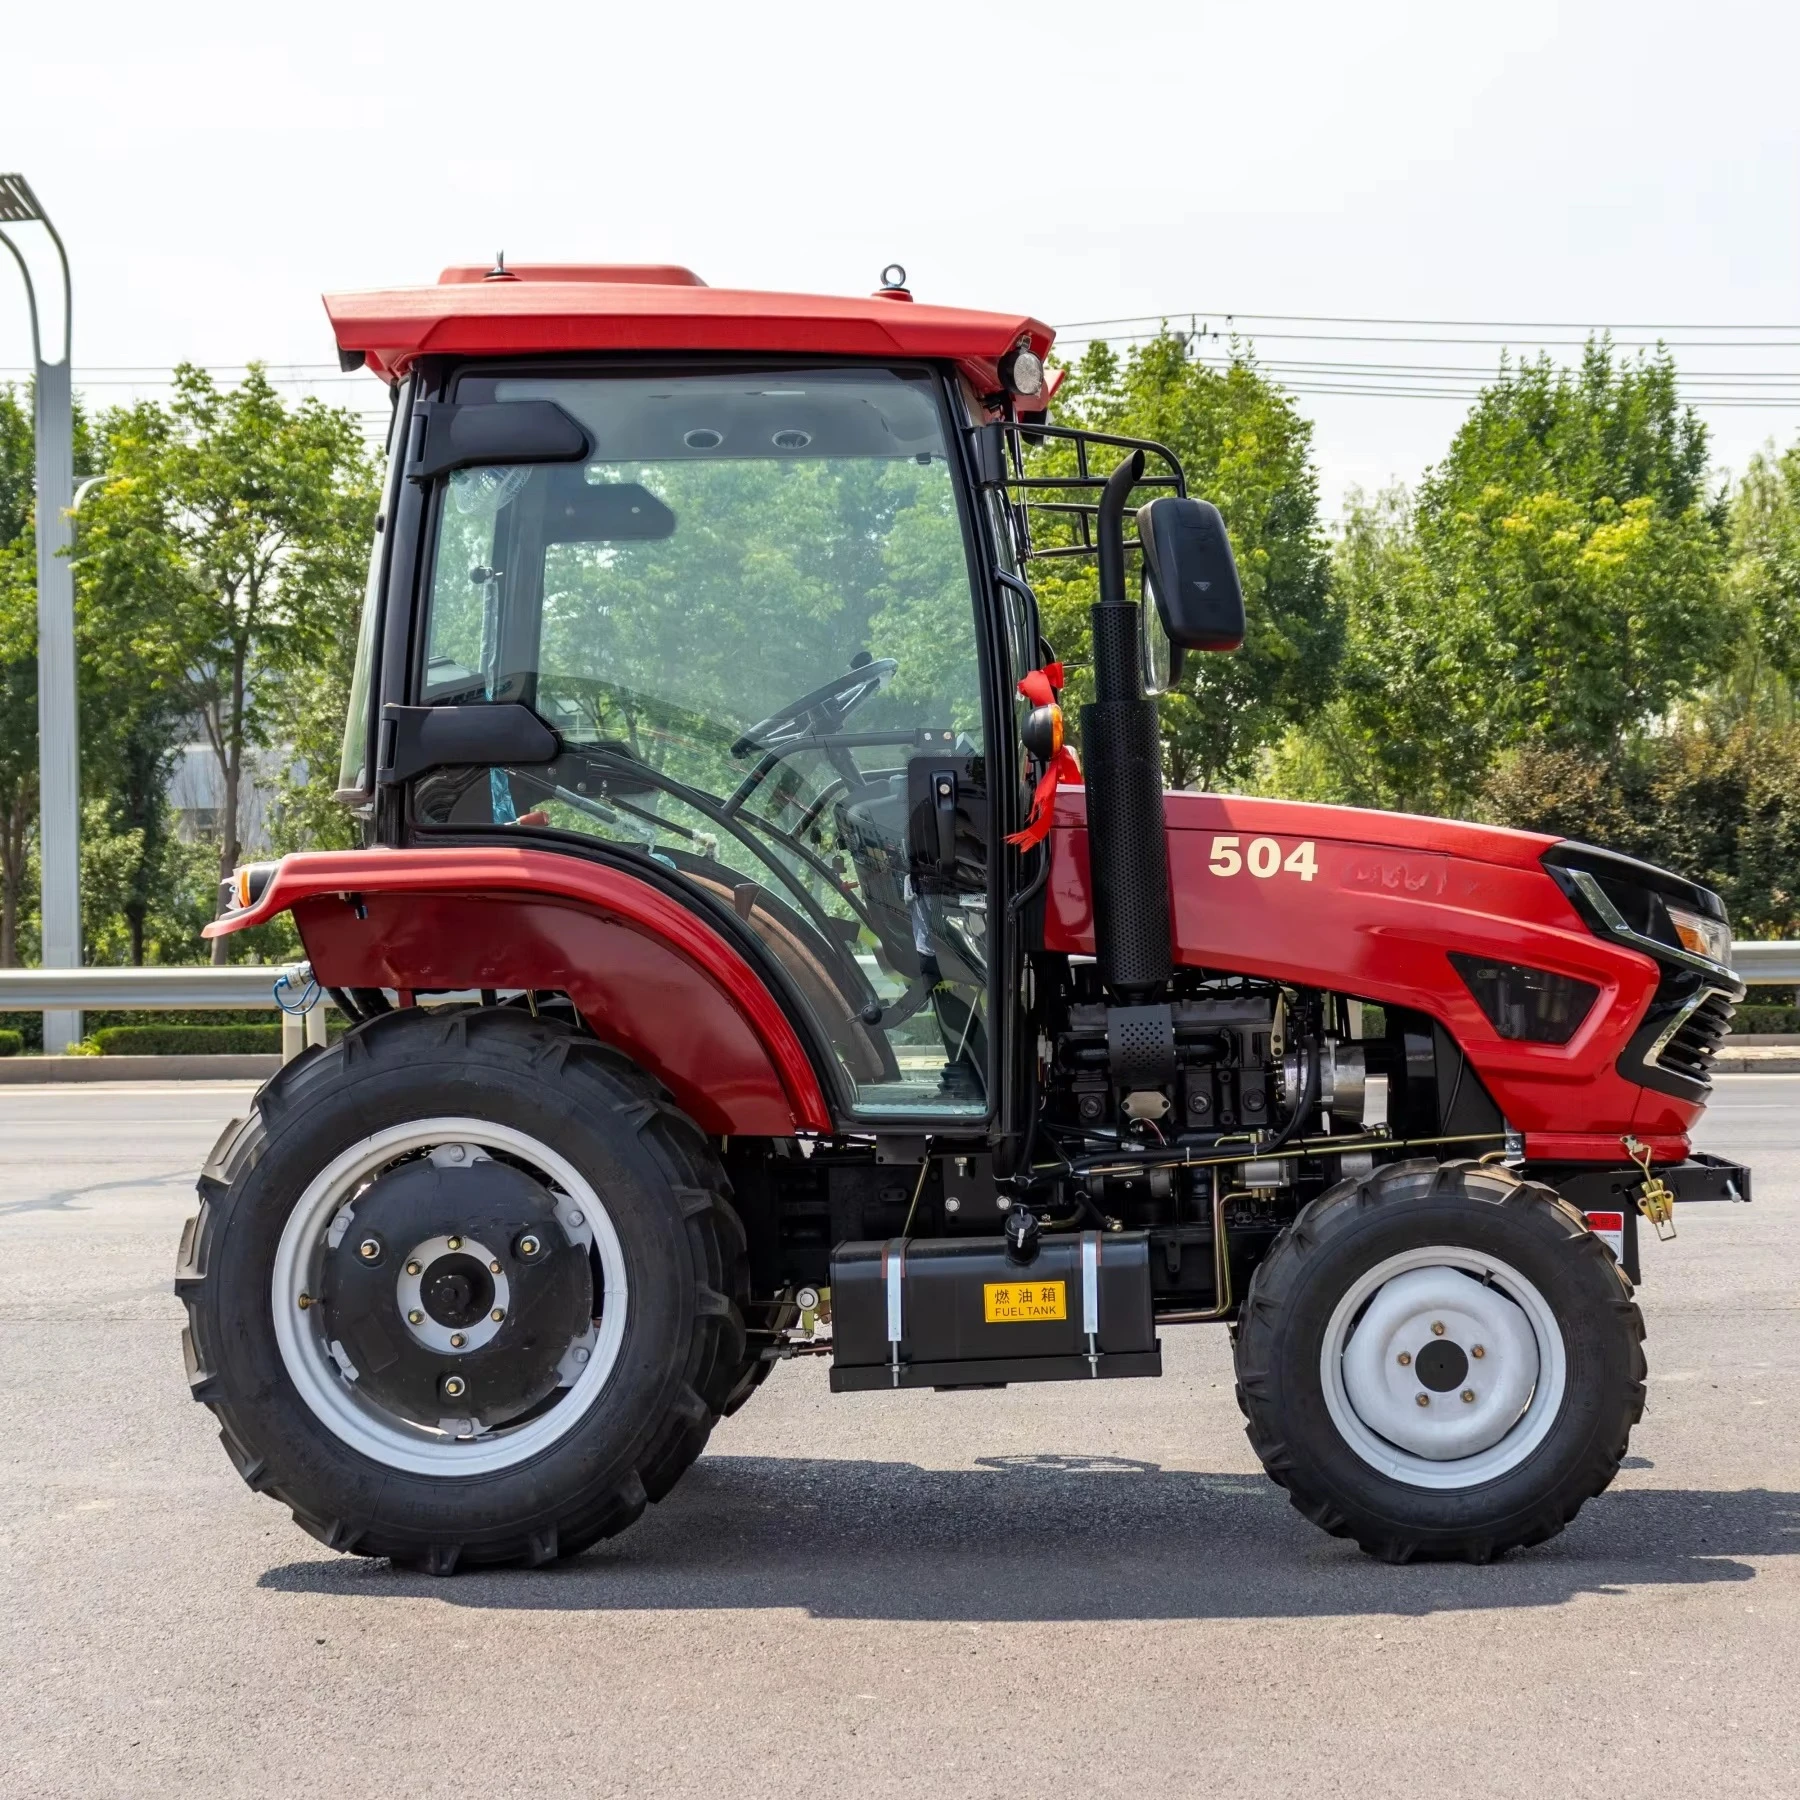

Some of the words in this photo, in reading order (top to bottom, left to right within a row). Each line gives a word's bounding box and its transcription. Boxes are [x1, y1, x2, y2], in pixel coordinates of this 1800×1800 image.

[1208, 836, 1319, 881] 504
[994, 1287, 1056, 1304] 燃油箱
[995, 1307, 1024, 1317] FUEL
[1027, 1305, 1057, 1315] TANK
